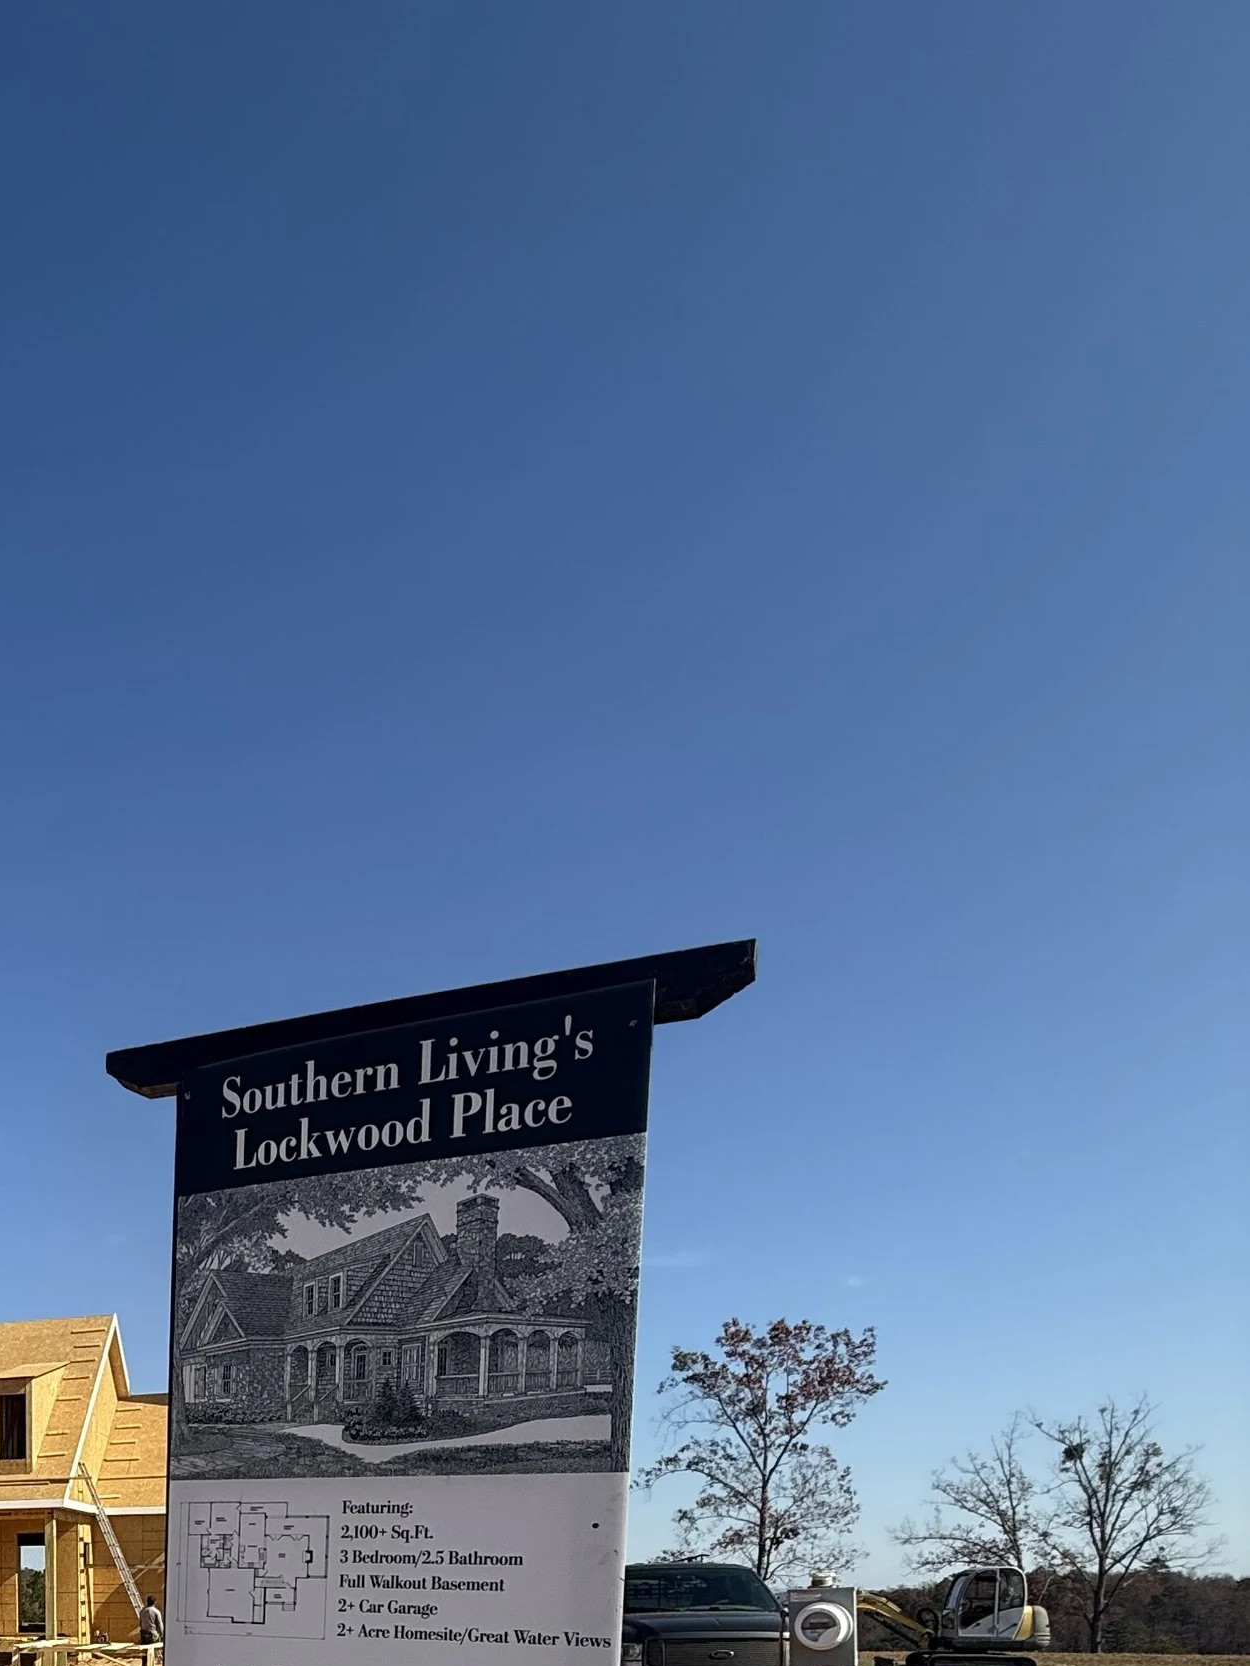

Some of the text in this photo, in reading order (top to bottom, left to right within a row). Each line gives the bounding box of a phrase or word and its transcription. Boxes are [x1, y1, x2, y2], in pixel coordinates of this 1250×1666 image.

[221, 1013, 595, 1120] Southern Living's
[233, 1088, 574, 1171] Lockwood Place
[341, 1500, 414, 1518] Featuring:
[340, 1524, 434, 1543] 2,100+ Sq.Ft.
[339, 1550, 524, 1568] 3 Bedroom/2.5 Bathroom
[338, 1574, 506, 1593] Full Walkout Basement
[337, 1598, 439, 1620] 2+ Car Garage
[336, 1623, 612, 1649] 2+ Acre Homesite/Great Water Views
